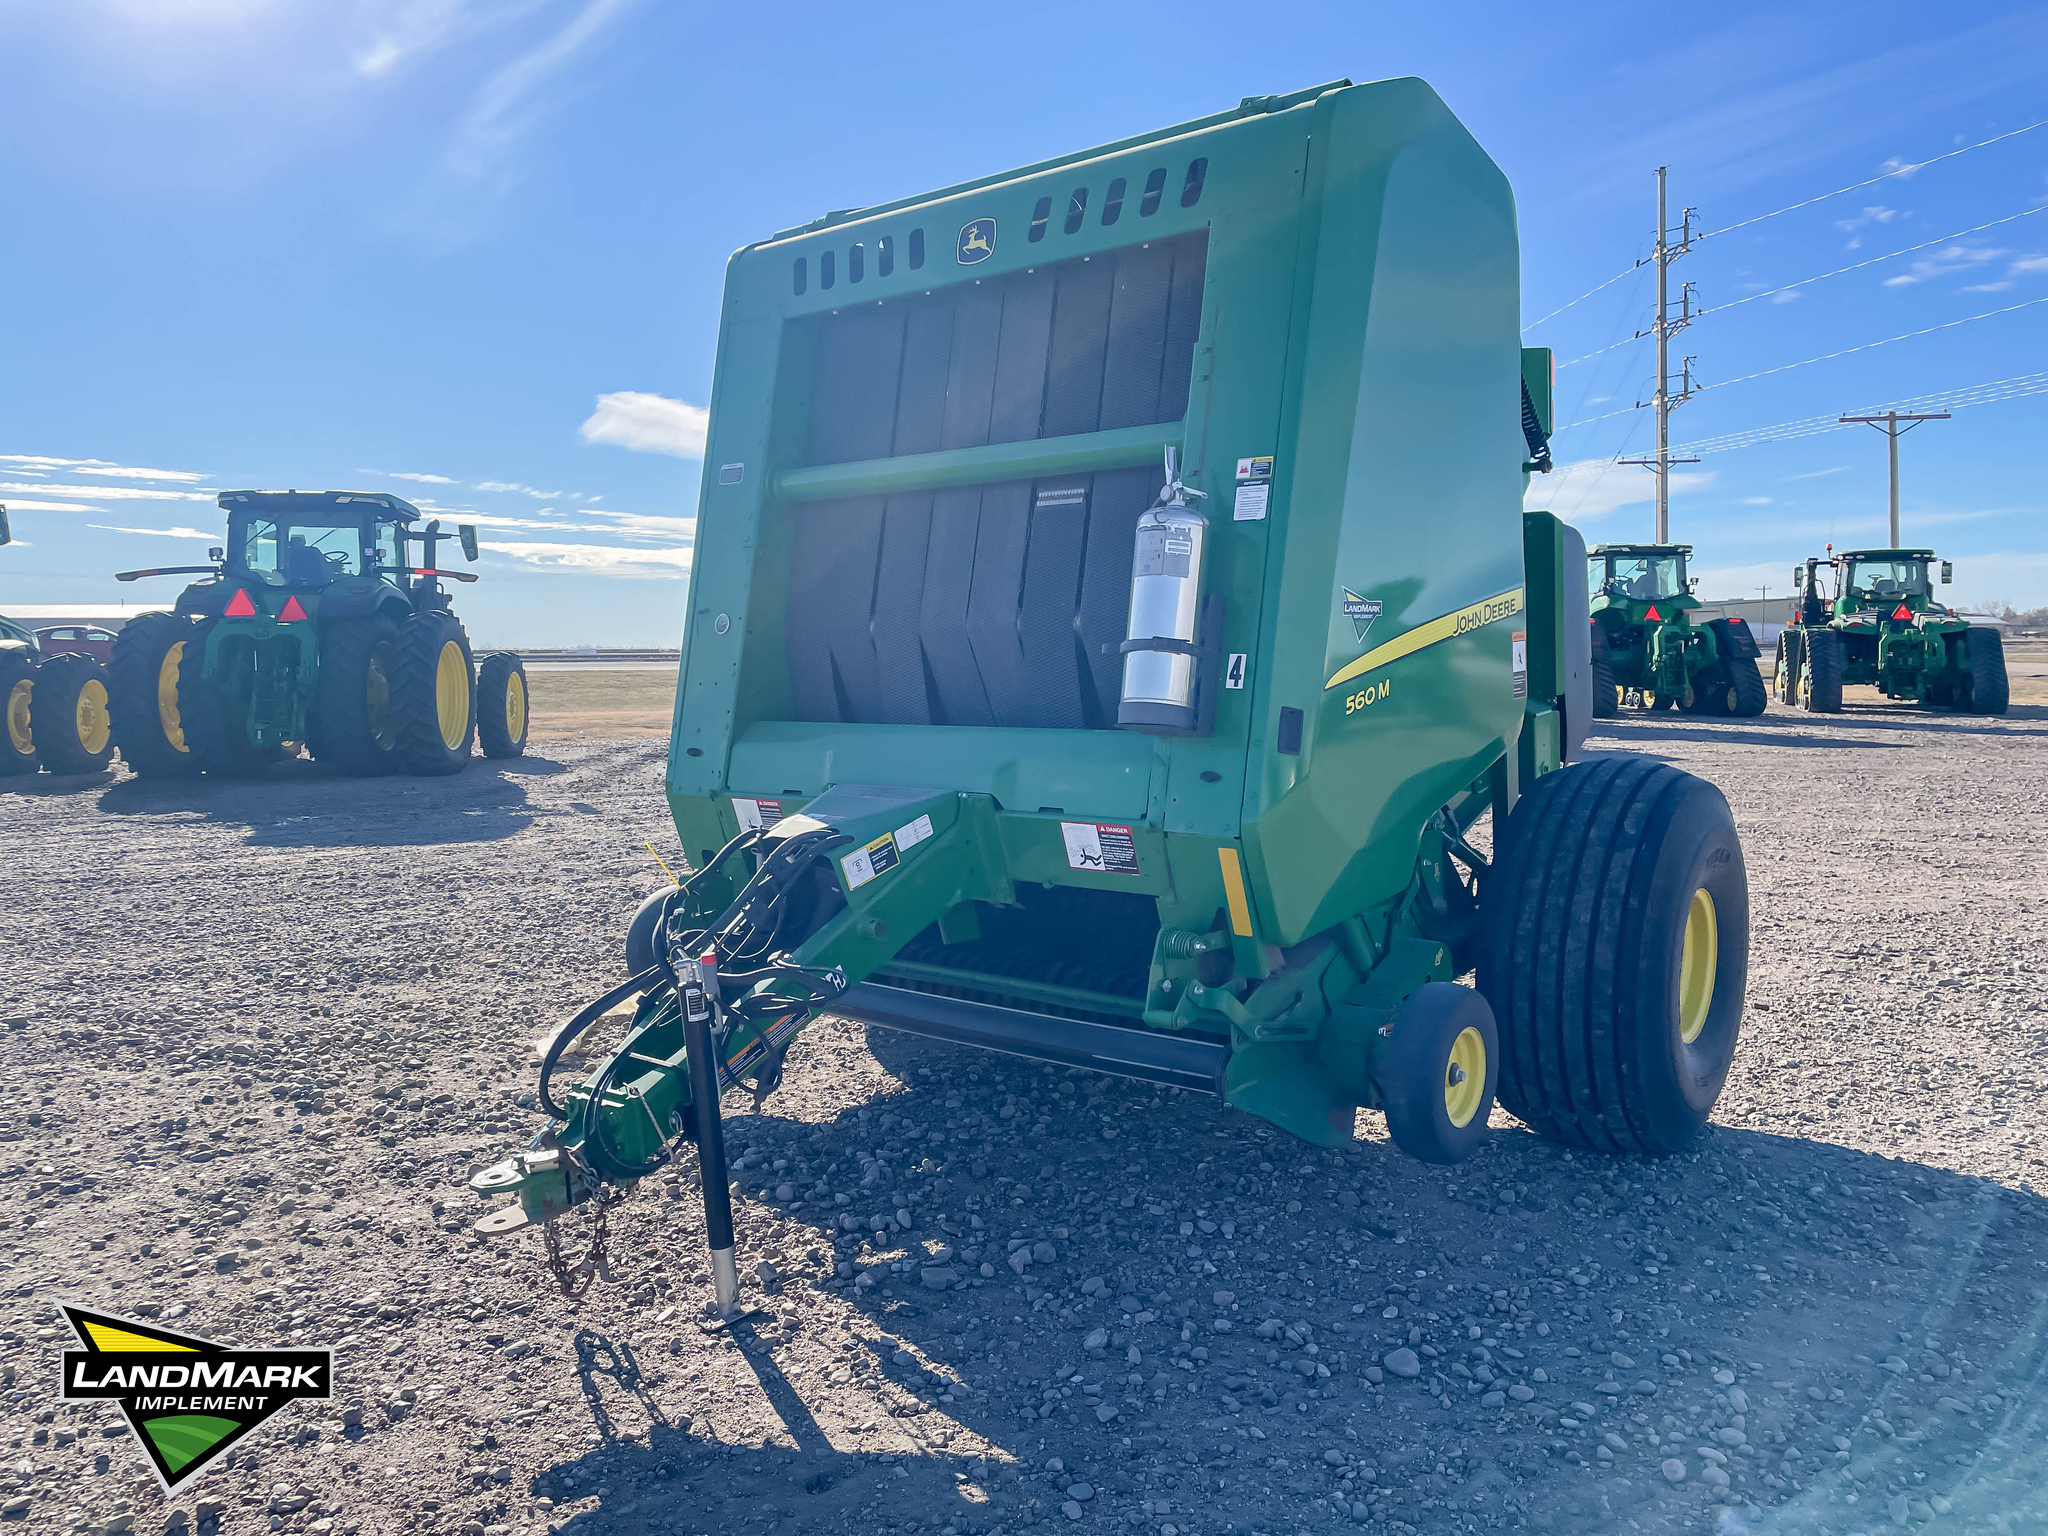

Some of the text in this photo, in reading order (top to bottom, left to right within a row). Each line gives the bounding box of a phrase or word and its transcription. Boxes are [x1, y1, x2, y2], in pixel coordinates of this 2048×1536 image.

[1452, 598, 1517, 635] JOHN DEERE
[1229, 655, 1242, 687] 4
[1345, 678, 1390, 716] 560 M
[1105, 826, 1128, 834] DANGER
